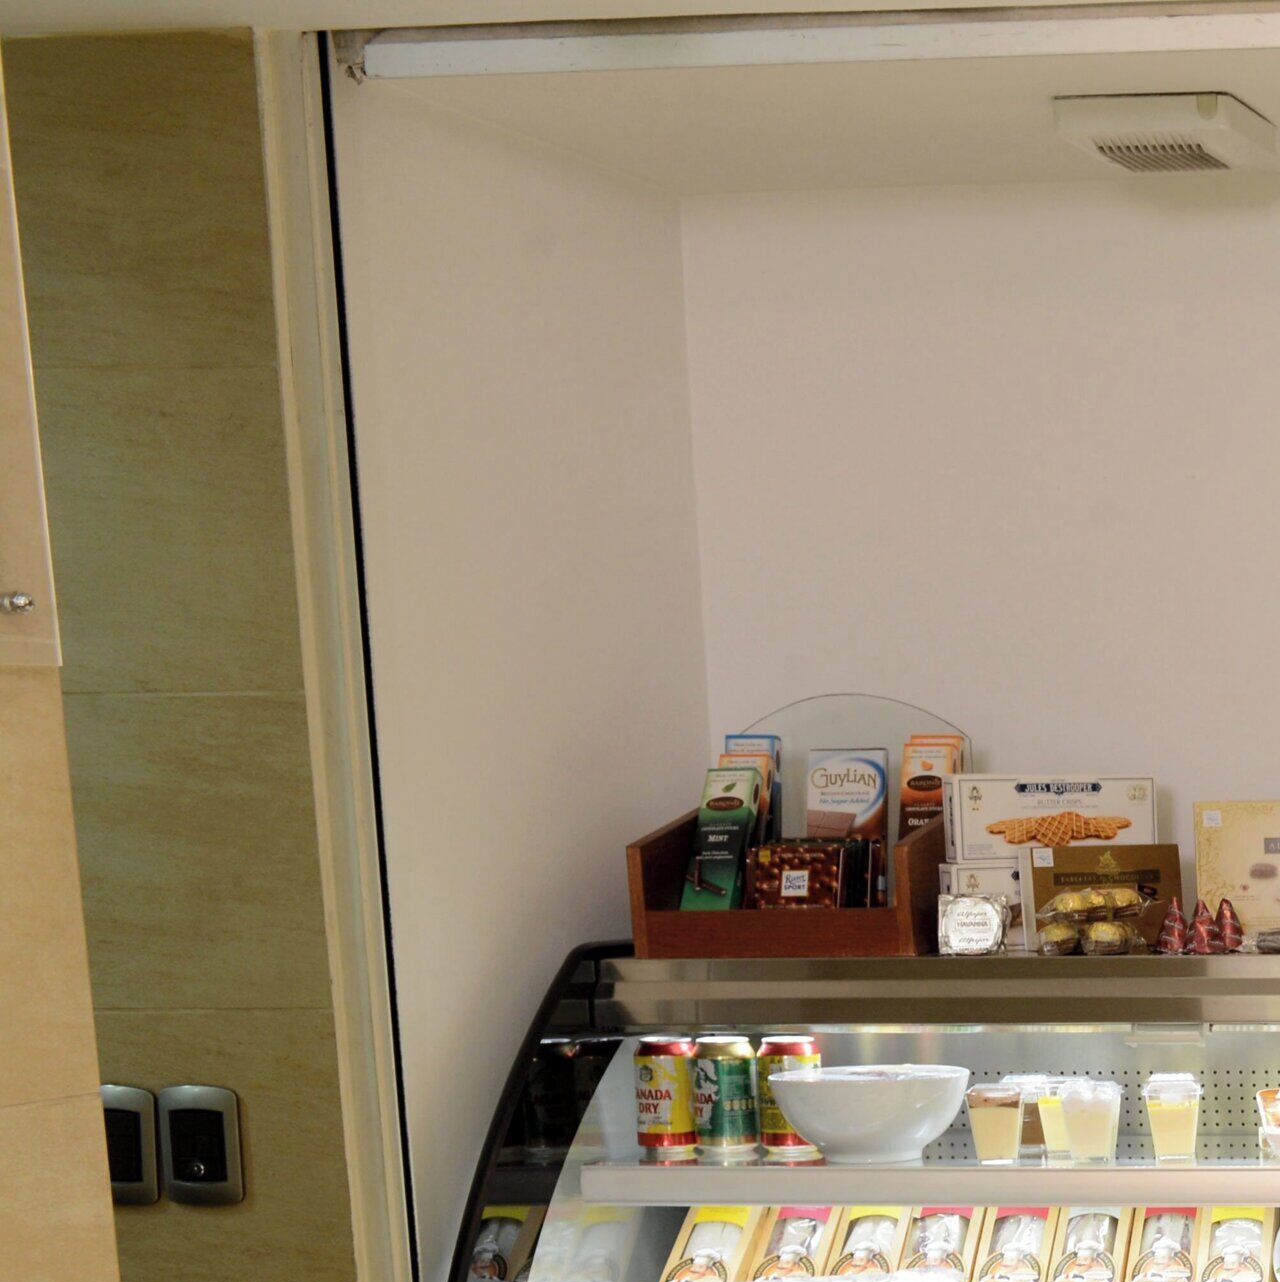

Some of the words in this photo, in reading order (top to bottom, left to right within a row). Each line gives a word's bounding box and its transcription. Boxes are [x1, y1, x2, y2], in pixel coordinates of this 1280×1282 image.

[1024, 783, 1047, 793] JULES
[1049, 783, 1093, 793] DESTROOPER
[639, 1102, 660, 1114] DRY
